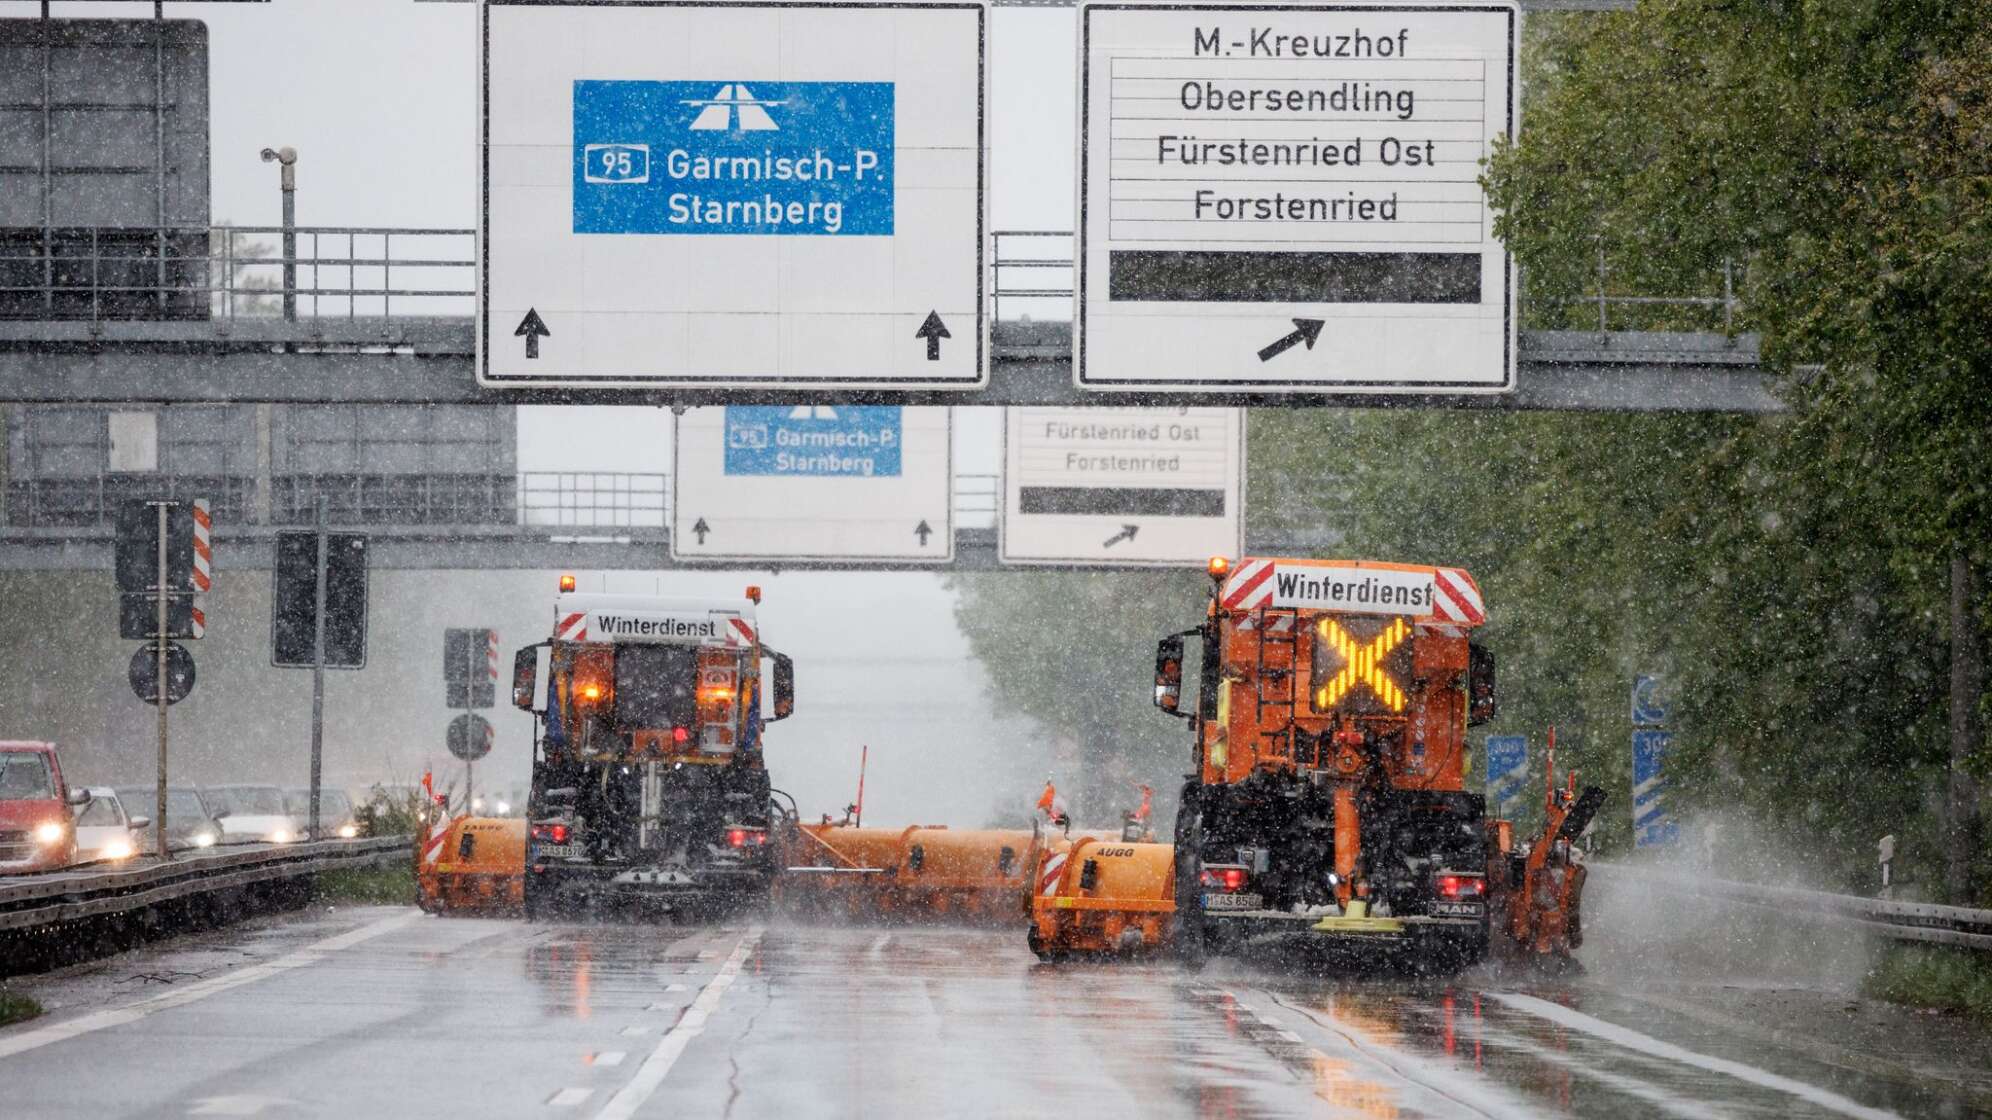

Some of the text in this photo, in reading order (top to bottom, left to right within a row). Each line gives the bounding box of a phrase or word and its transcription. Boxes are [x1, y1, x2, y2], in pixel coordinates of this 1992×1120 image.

[1194, 27, 1408, 58] M.-Kreuzhof
[1181, 82, 1415, 120] Obersendling
[602, 149, 884, 182] 95 Garmisch-P.
[1158, 136, 1435, 166] Fürstenried Ost
[668, 194, 843, 233] Starnberg
[1195, 190, 1397, 220] Forstenried
[1046, 422, 1200, 441] Fürstenried Ost
[776, 453, 874, 476] Starnberg
[1067, 453, 1180, 471] Forstenried
[1277, 573, 1433, 606] Winterdienst
[599, 616, 716, 636] Winterdienst
